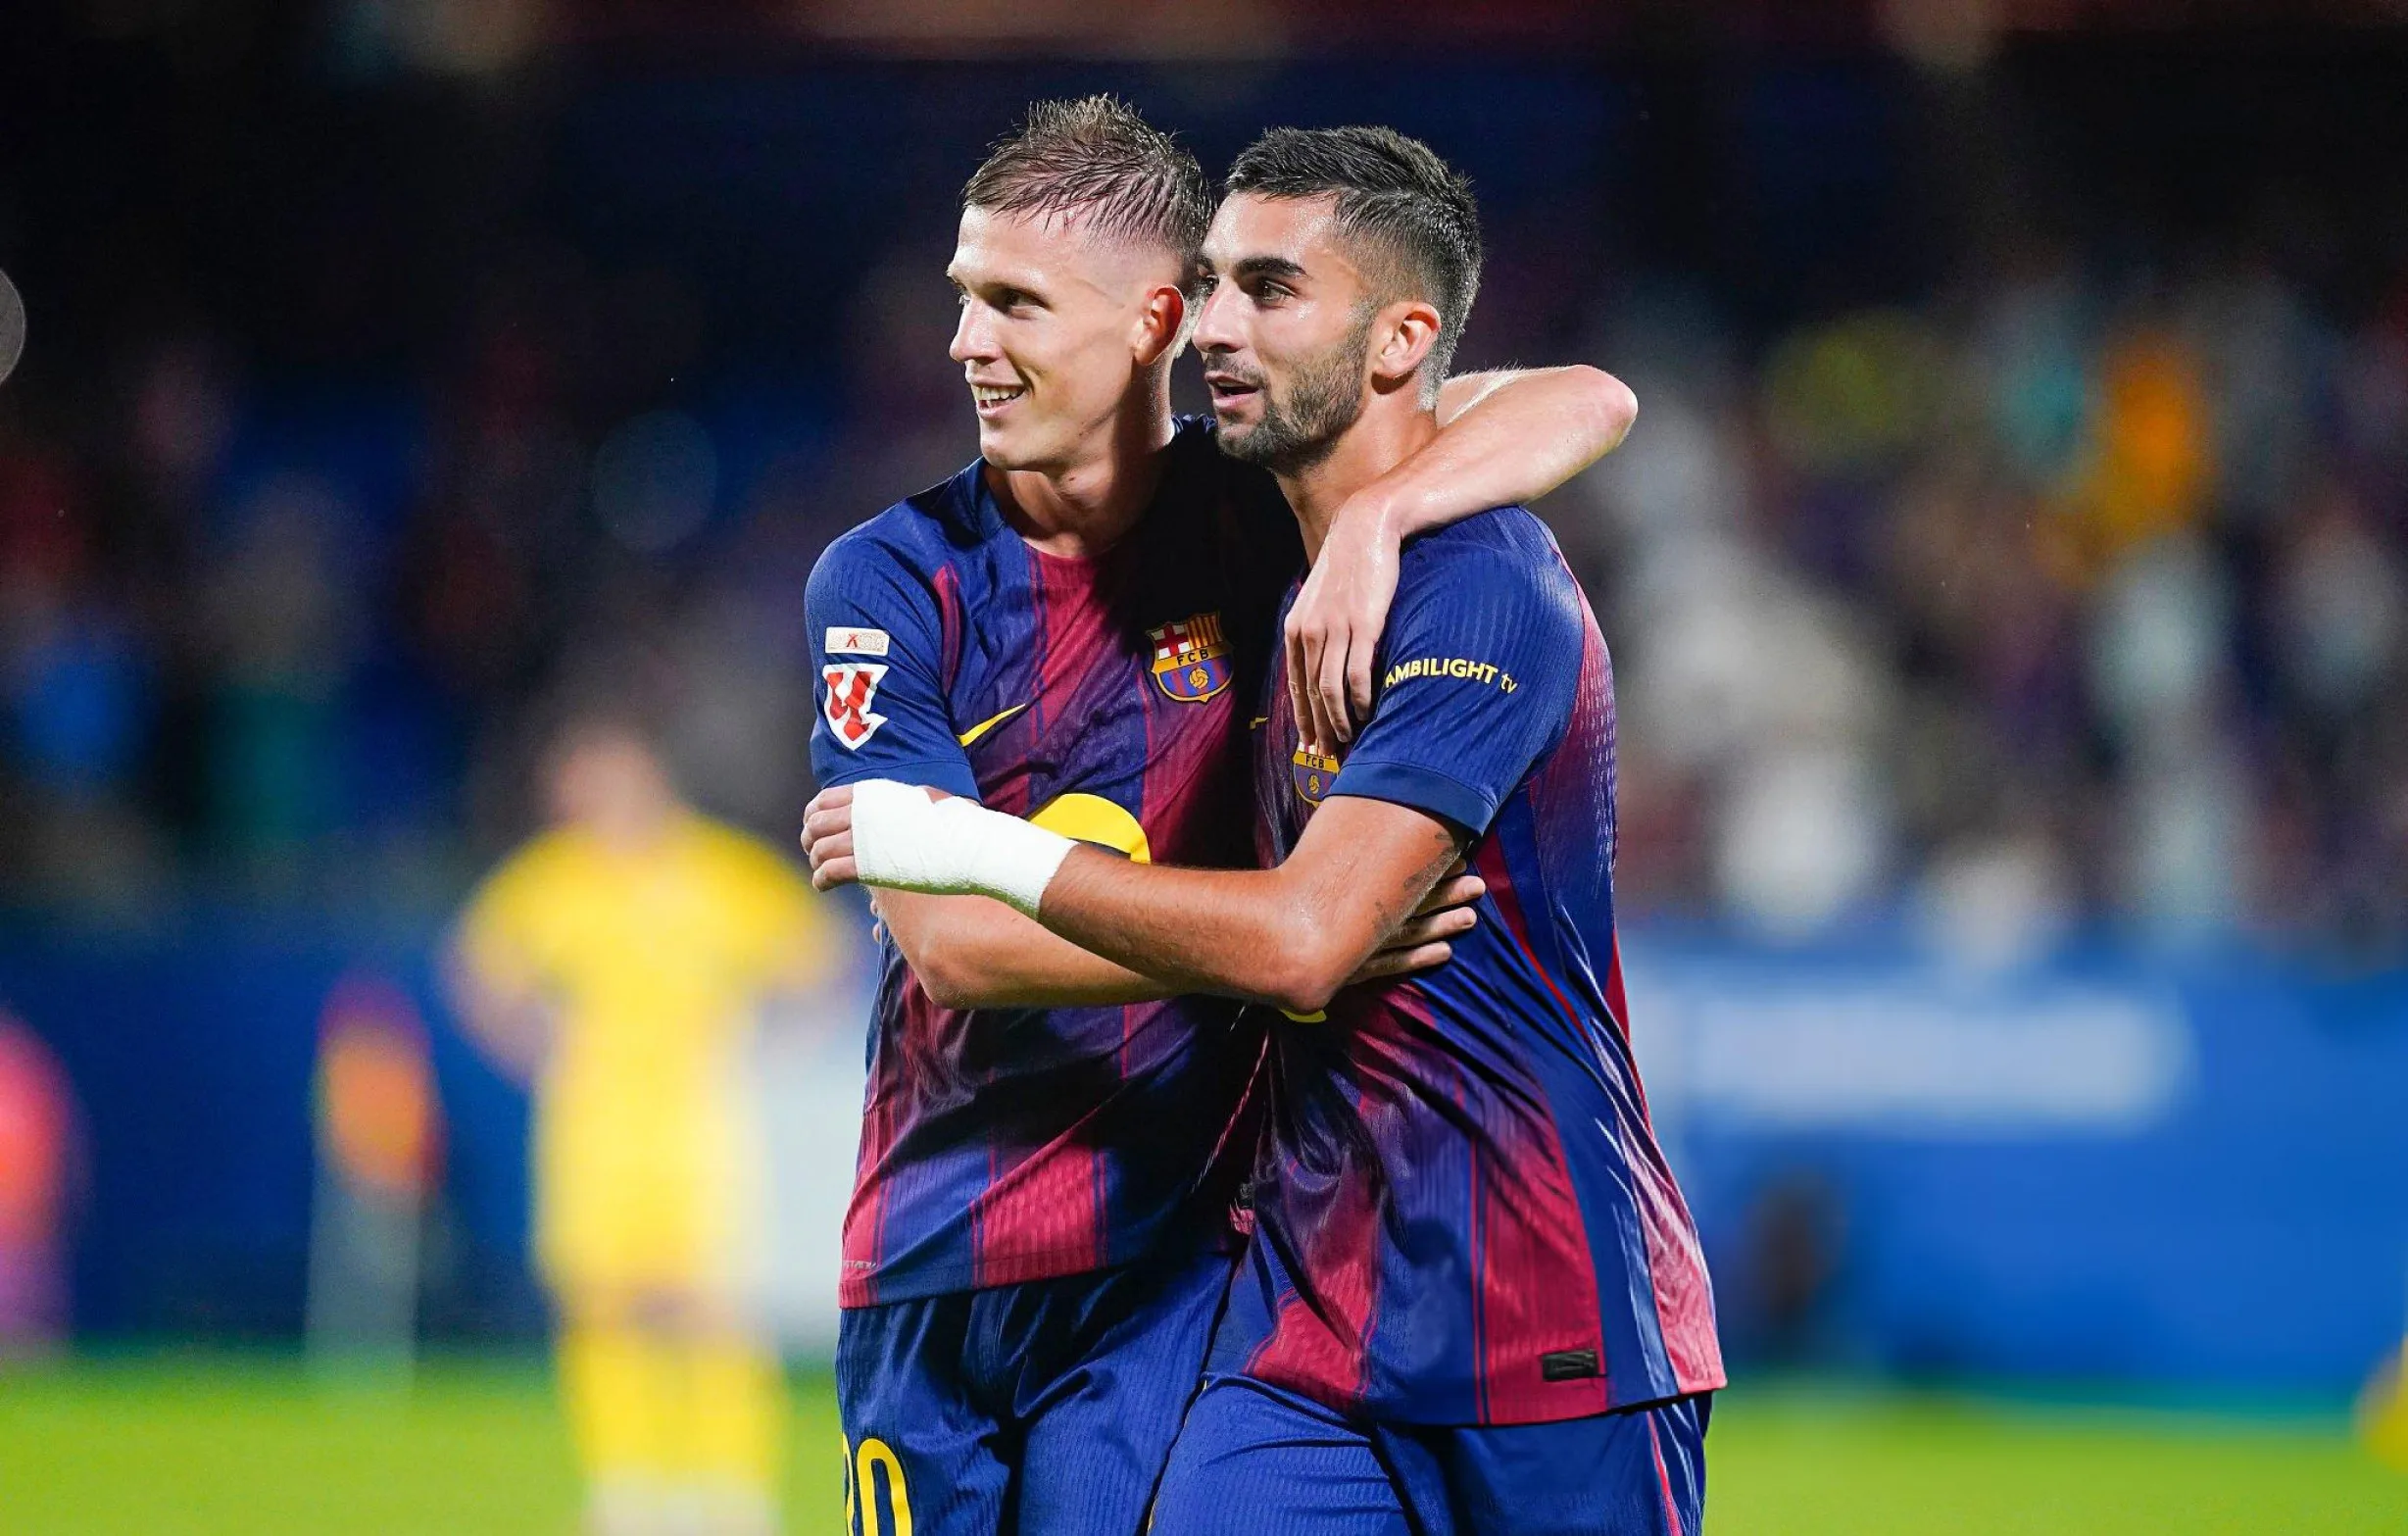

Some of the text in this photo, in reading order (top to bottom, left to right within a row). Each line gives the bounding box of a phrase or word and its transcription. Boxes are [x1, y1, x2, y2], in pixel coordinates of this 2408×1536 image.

[1176, 648, 1209, 667] FCB
[1385, 658, 1518, 694] AMBILIGHT tv
[1305, 754, 1325, 769] FCB
